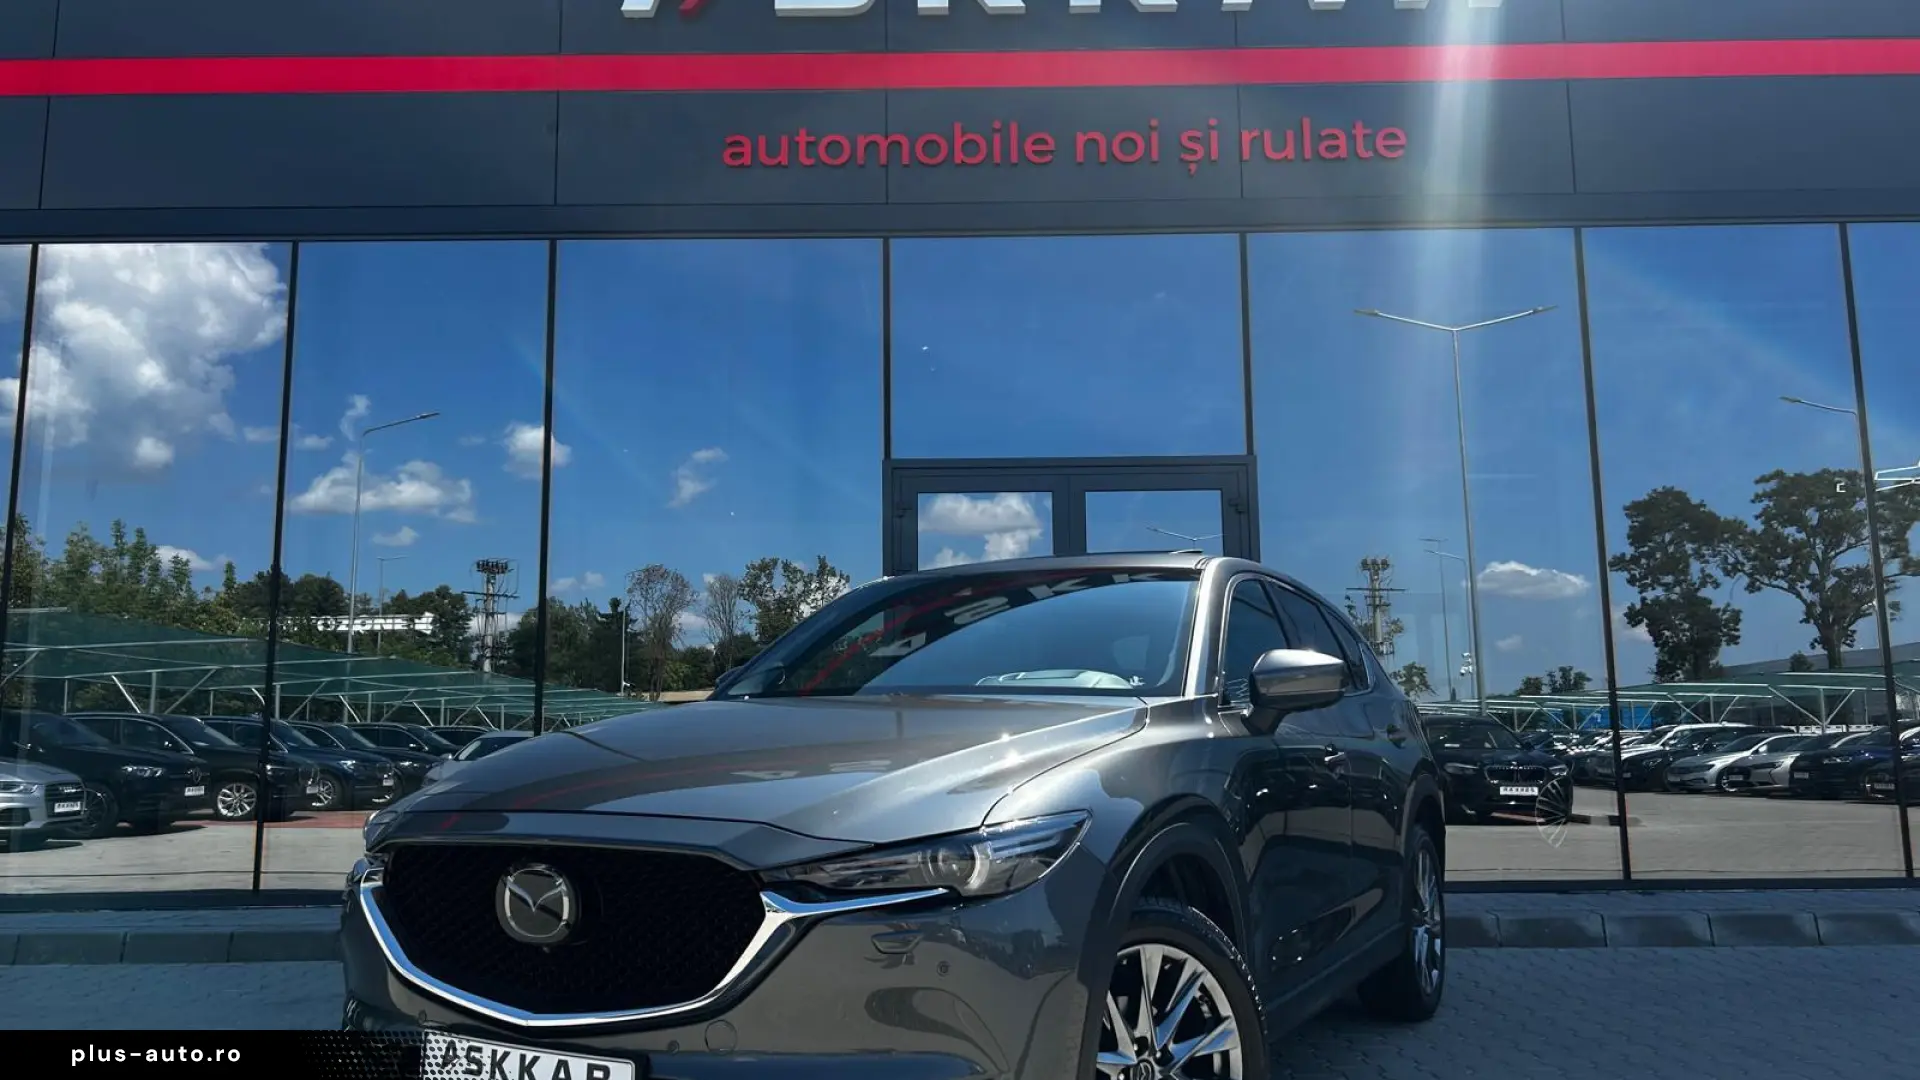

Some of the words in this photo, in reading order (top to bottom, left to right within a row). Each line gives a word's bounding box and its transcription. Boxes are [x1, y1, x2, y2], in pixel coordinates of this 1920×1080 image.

[722, 121, 1055, 167] automobile
[1075, 120, 1159, 163] noi
[1180, 119, 1219, 174] și
[1240, 118, 1407, 161] rulate
